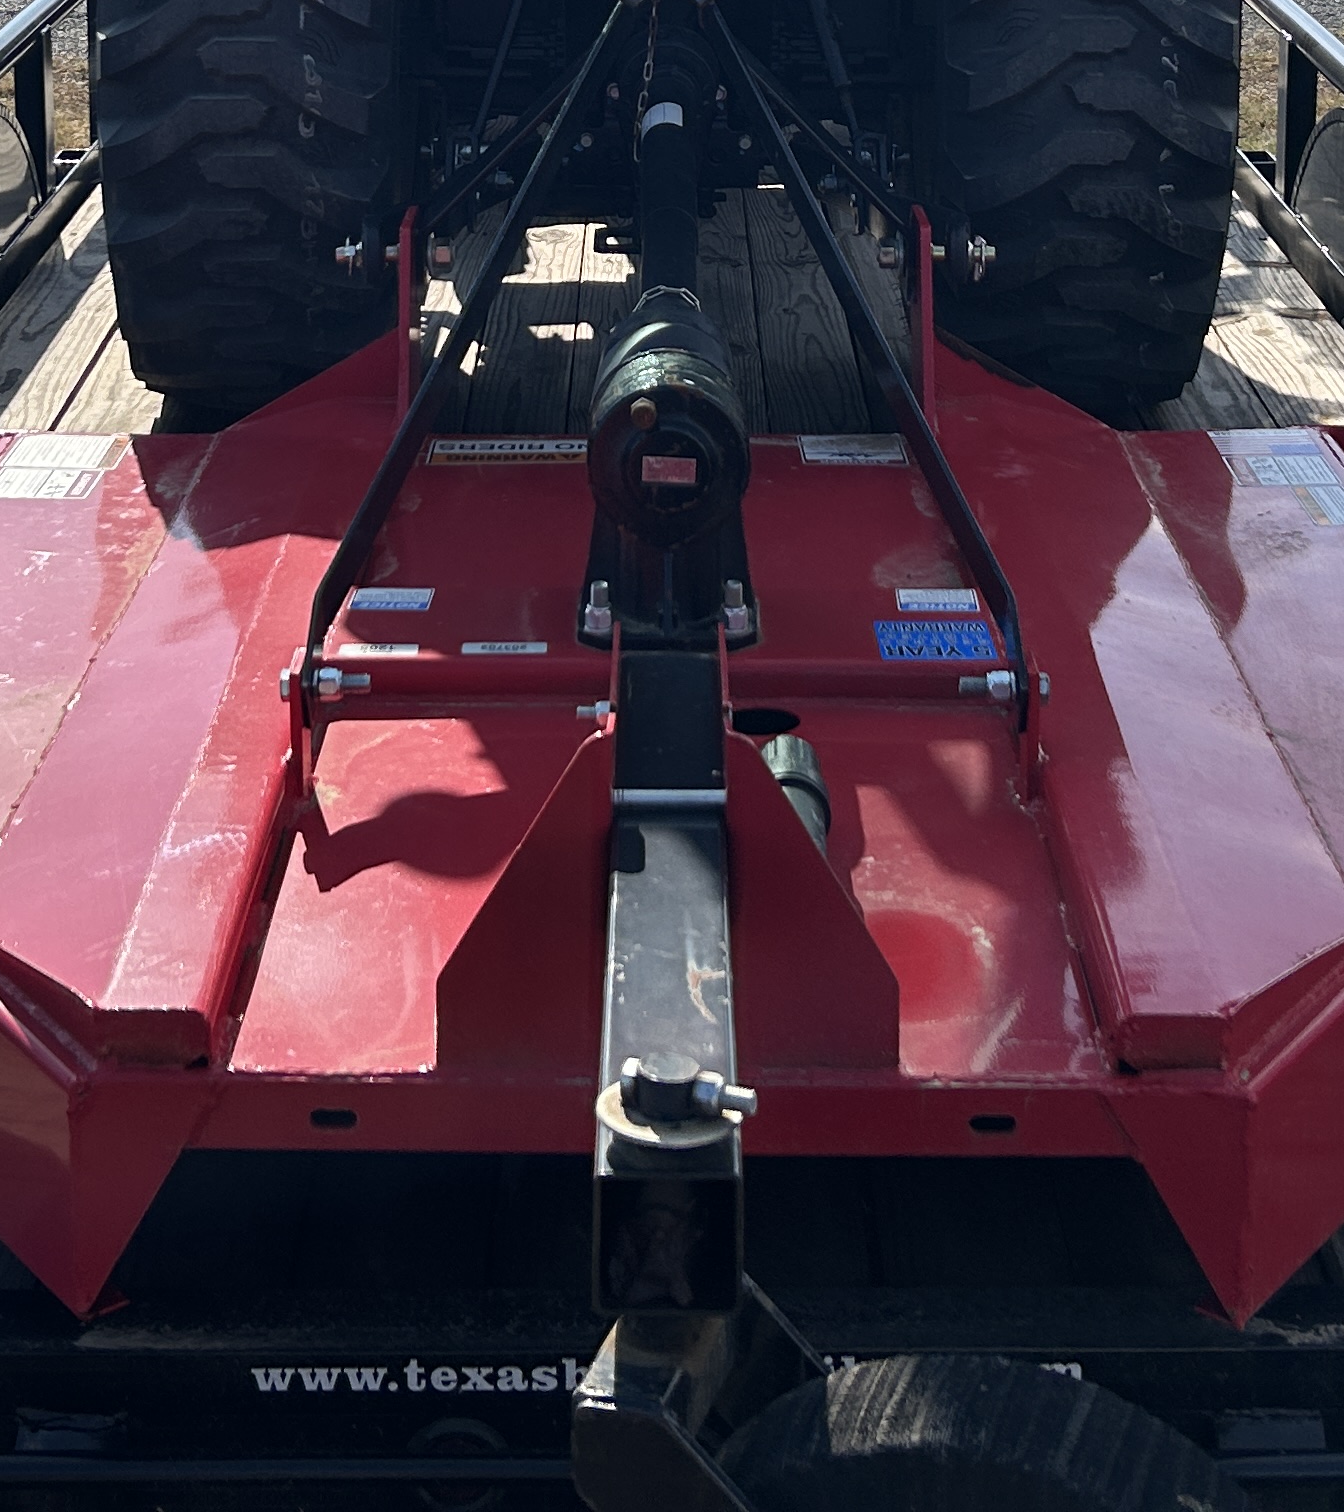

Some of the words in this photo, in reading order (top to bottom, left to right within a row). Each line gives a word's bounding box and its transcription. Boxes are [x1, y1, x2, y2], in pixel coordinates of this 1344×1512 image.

[438, 442, 545, 451] RIDERS
[357, 601, 420, 609] NOTICE
[877, 622, 985, 633] WARRANTY
[884, 644, 965, 658] YEAR
[972, 645, 992, 657] 5
